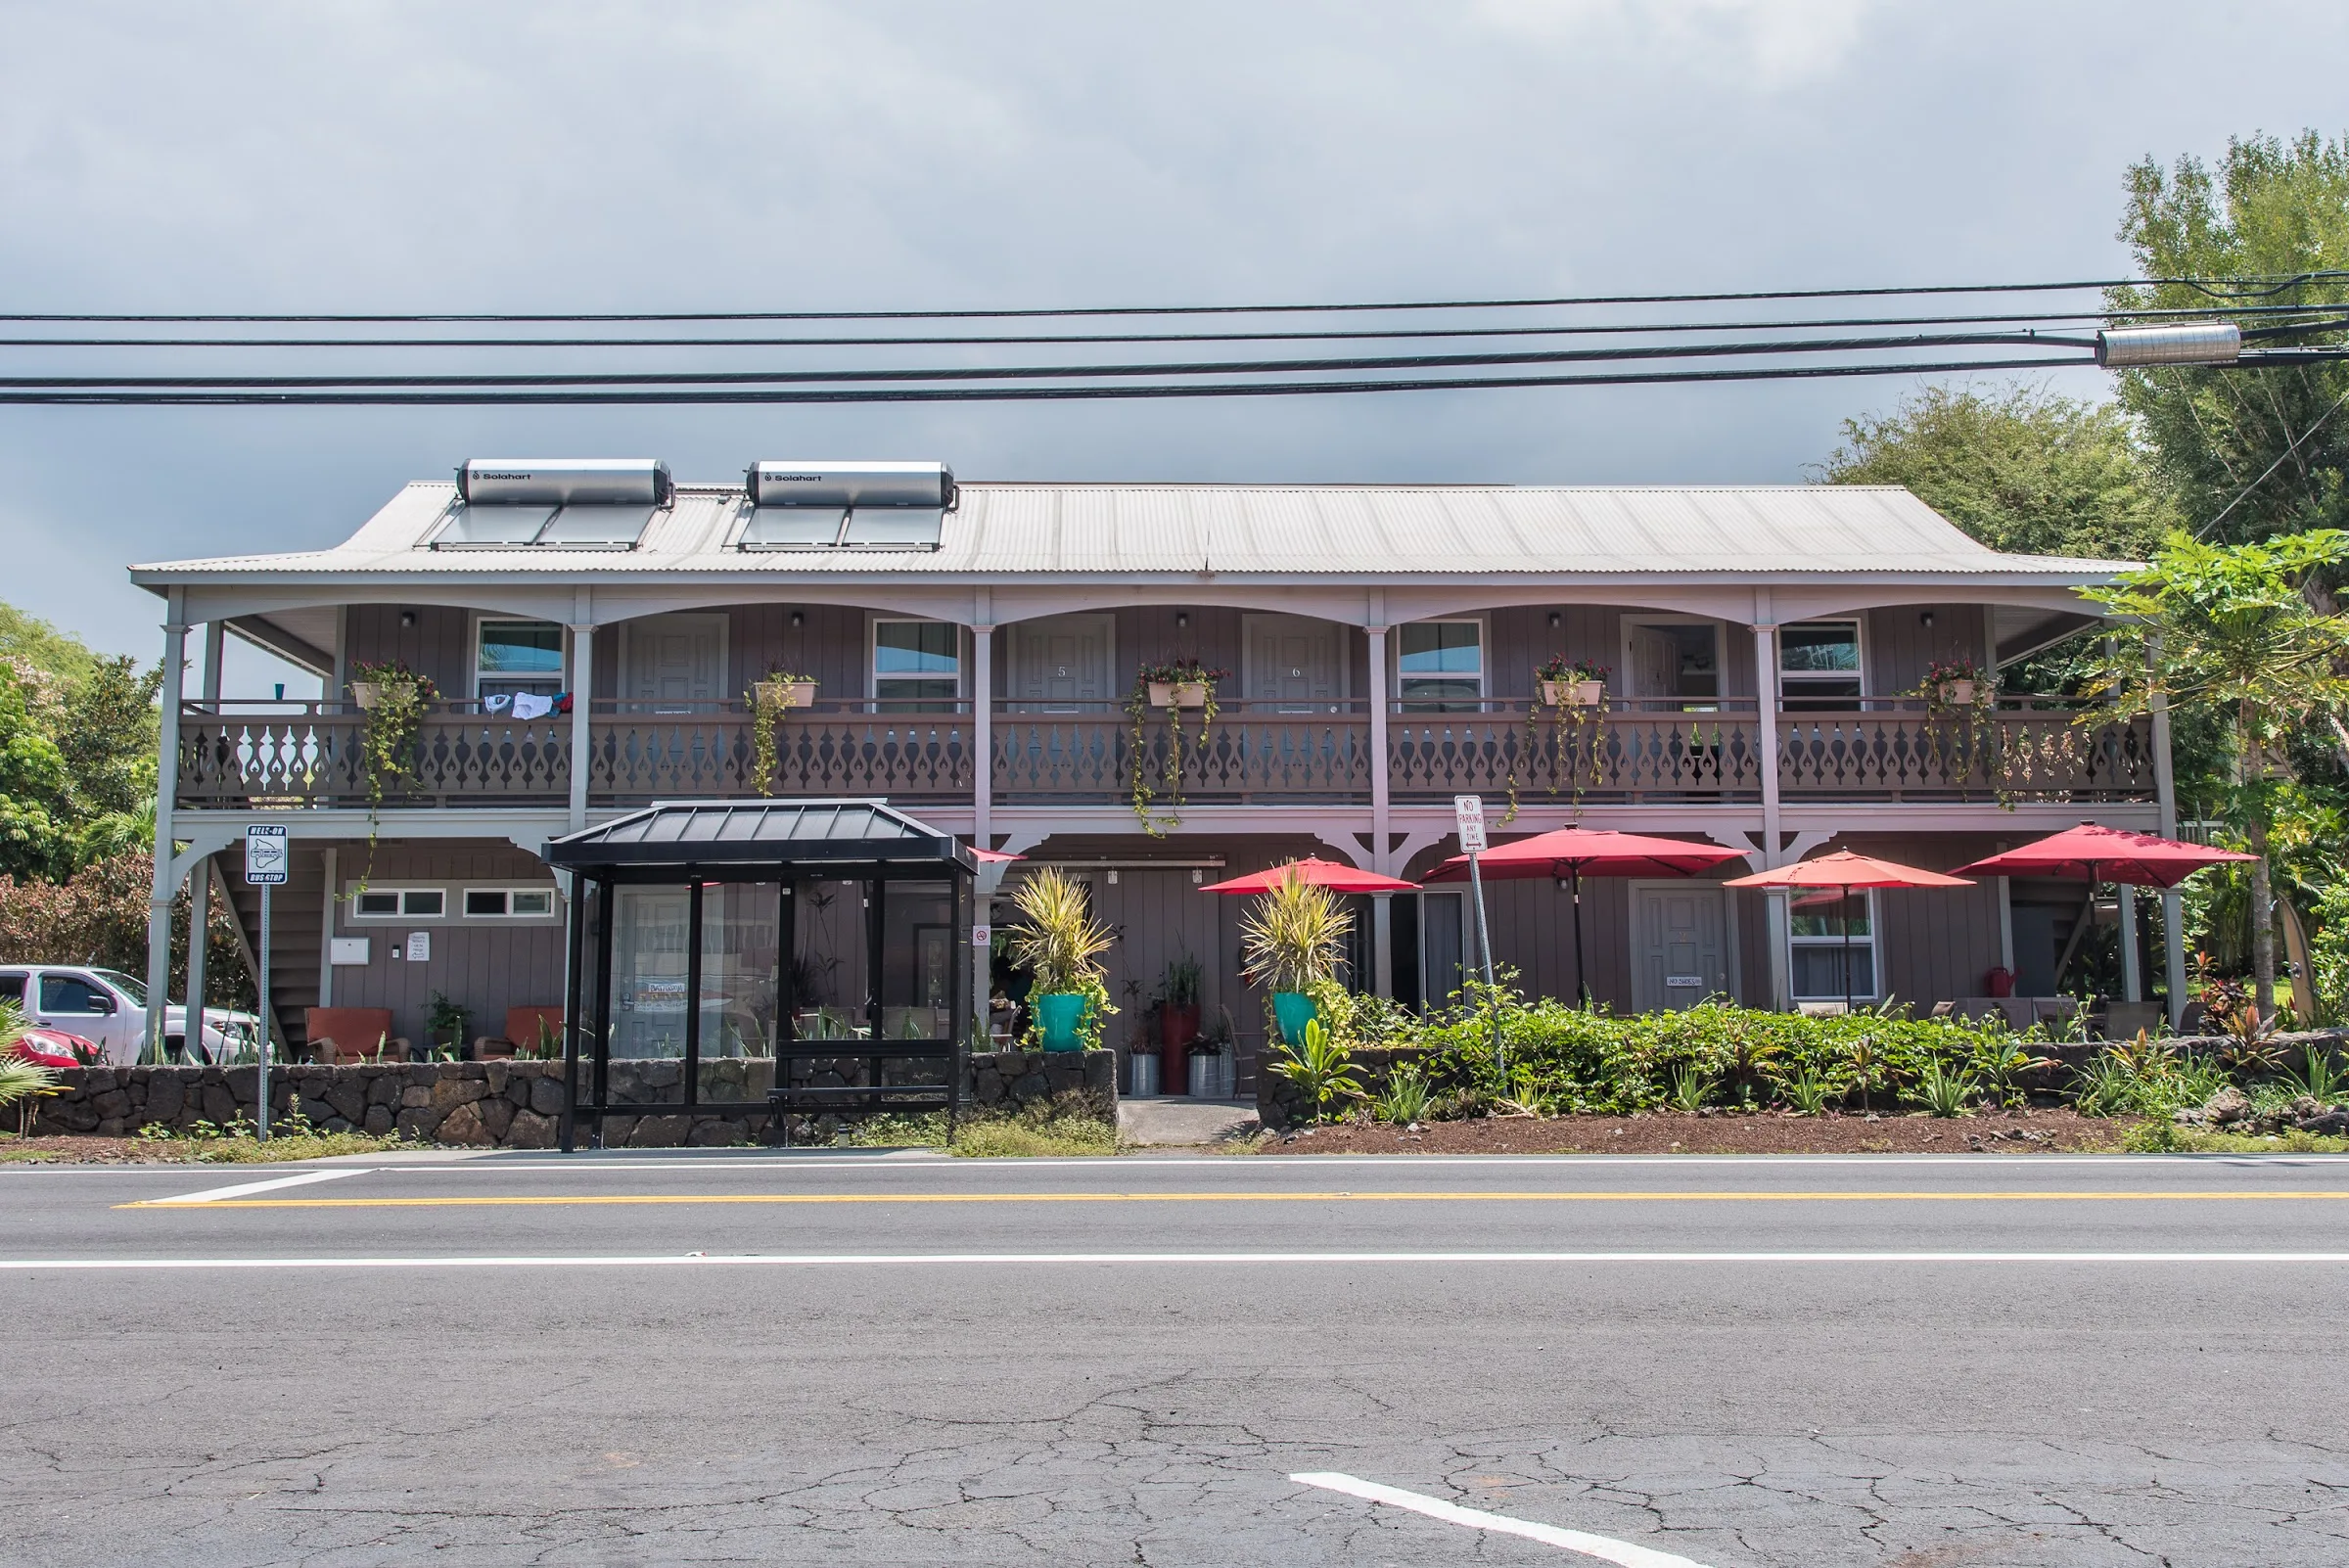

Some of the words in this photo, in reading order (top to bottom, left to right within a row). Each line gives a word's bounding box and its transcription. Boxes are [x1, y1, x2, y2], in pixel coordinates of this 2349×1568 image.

[1058, 666, 1066, 676] 5
[1292, 667, 1301, 677] 6
[1463, 801, 1474, 811] NO
[1459, 813, 1482, 823] PARKING
[250, 873, 265, 882] BUS
[265, 873, 284, 882] STOP
[650, 984, 683, 992] BATHROOM
